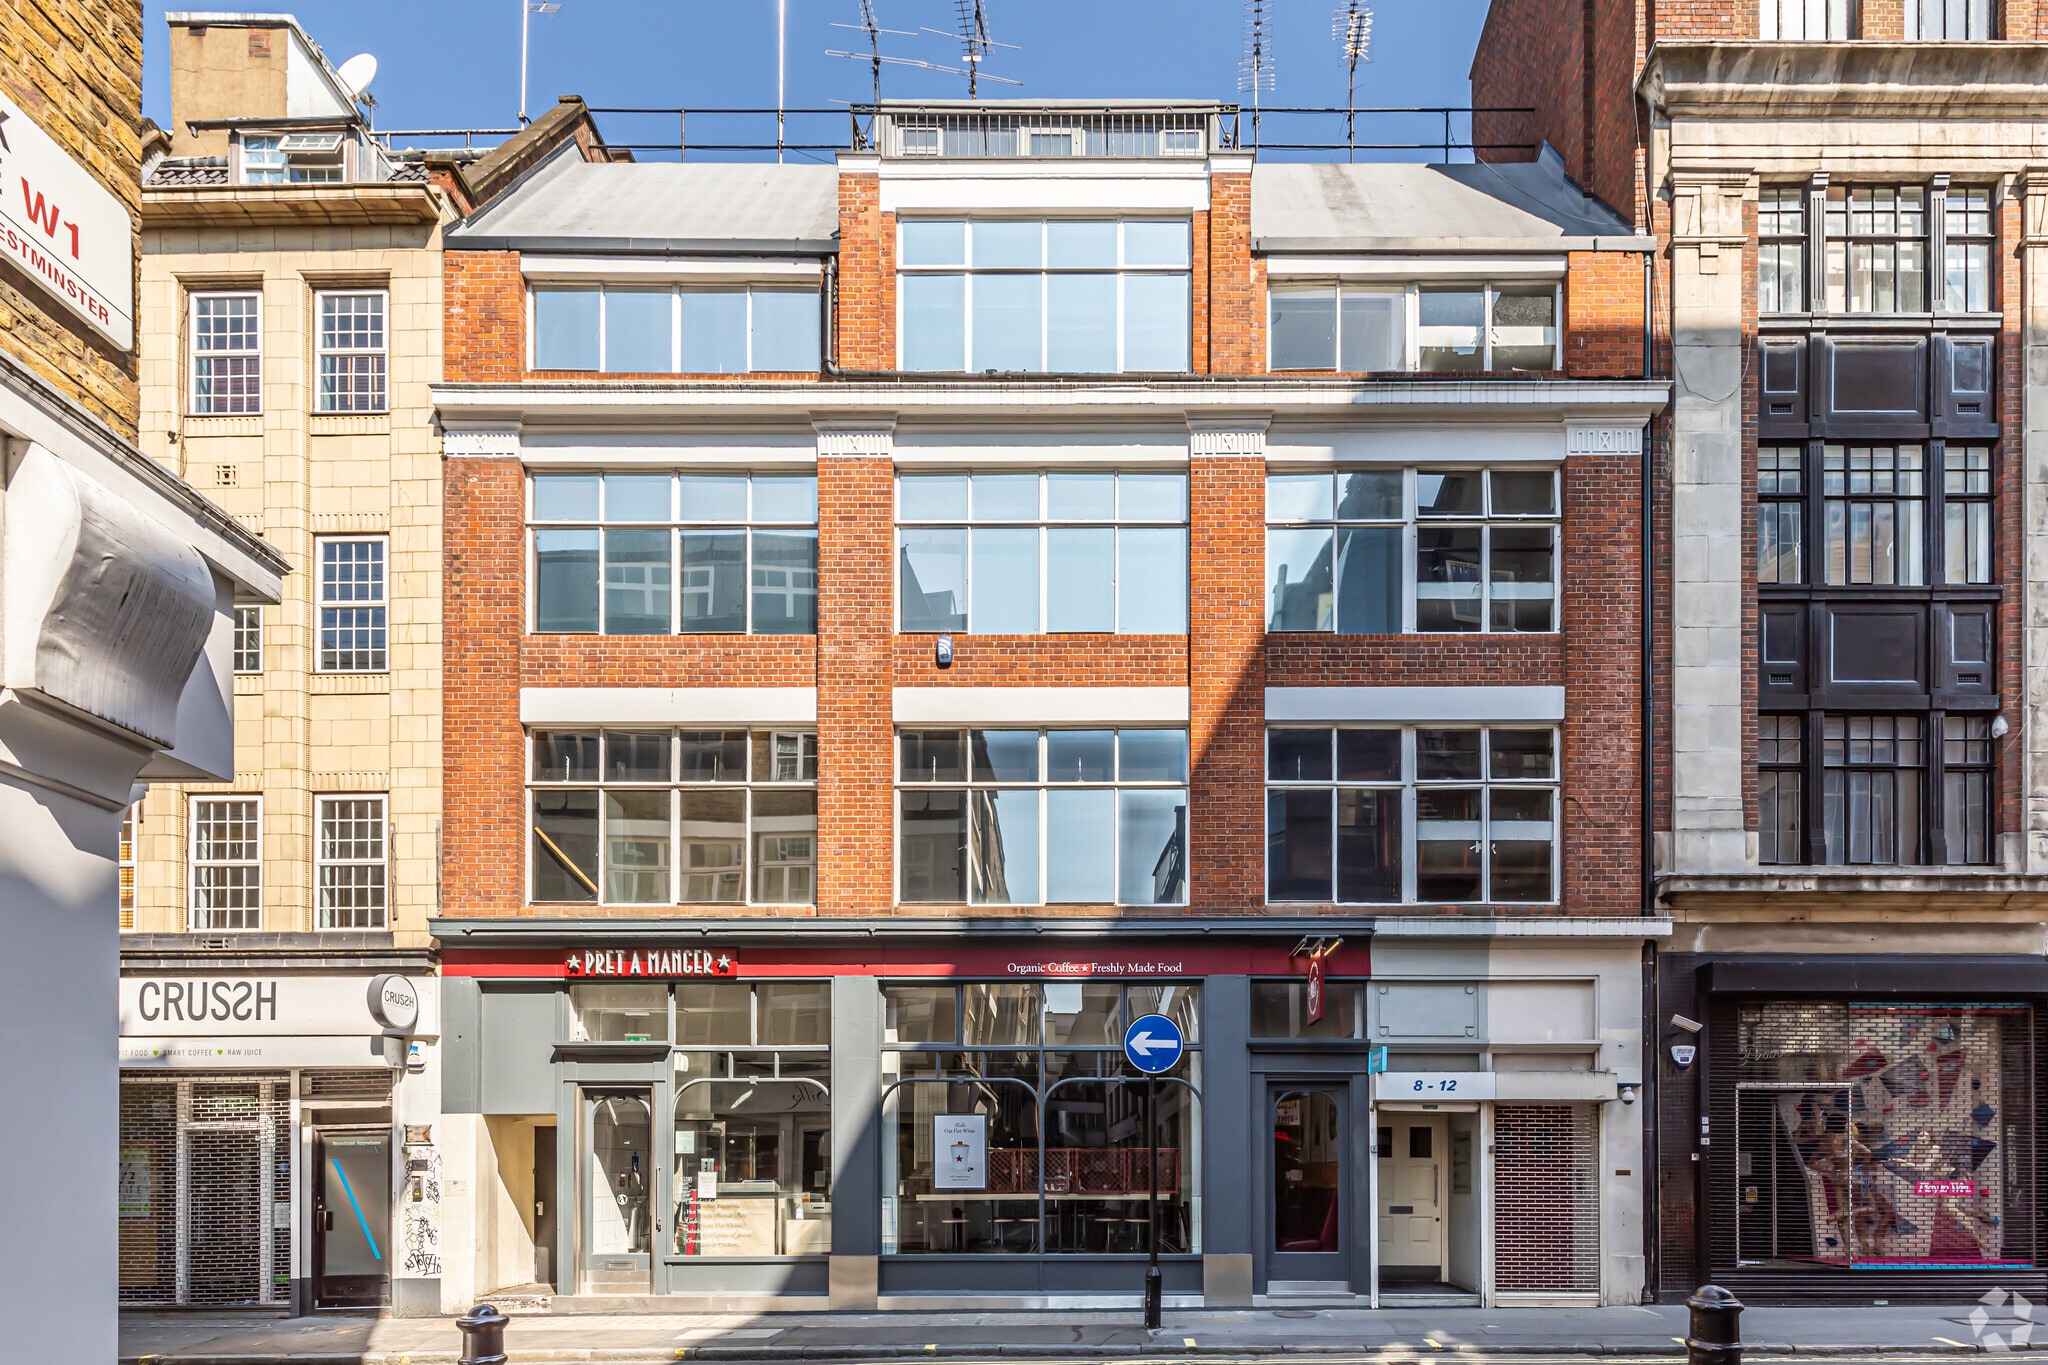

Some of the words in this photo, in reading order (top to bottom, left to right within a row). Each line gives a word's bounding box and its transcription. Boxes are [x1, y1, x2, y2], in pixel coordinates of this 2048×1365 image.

[21, 175, 80, 261] W1
[585, 950, 626, 974] PRET
[630, 950, 642, 974] A
[647, 950, 714, 974] MANGER
[1007, 962, 1046, 975] Organic
[1047, 961, 1079, 973] Coffee
[1091, 962, 1125, 975] Freshly
[1128, 962, 1156, 973] Made
[1157, 962, 1182, 973] Food
[139, 981, 277, 1021] CRUSSH
[384, 990, 415, 1008] CRUSSH
[130, 1049, 149, 1057] FOOD
[163, 1049, 186, 1057] SMART
[188, 1049, 213, 1057] COFFEE
[243, 1048, 263, 1056] JUICE
[1413, 1080, 1424, 1091] 8
[1439, 1080, 1457, 1091] 12
